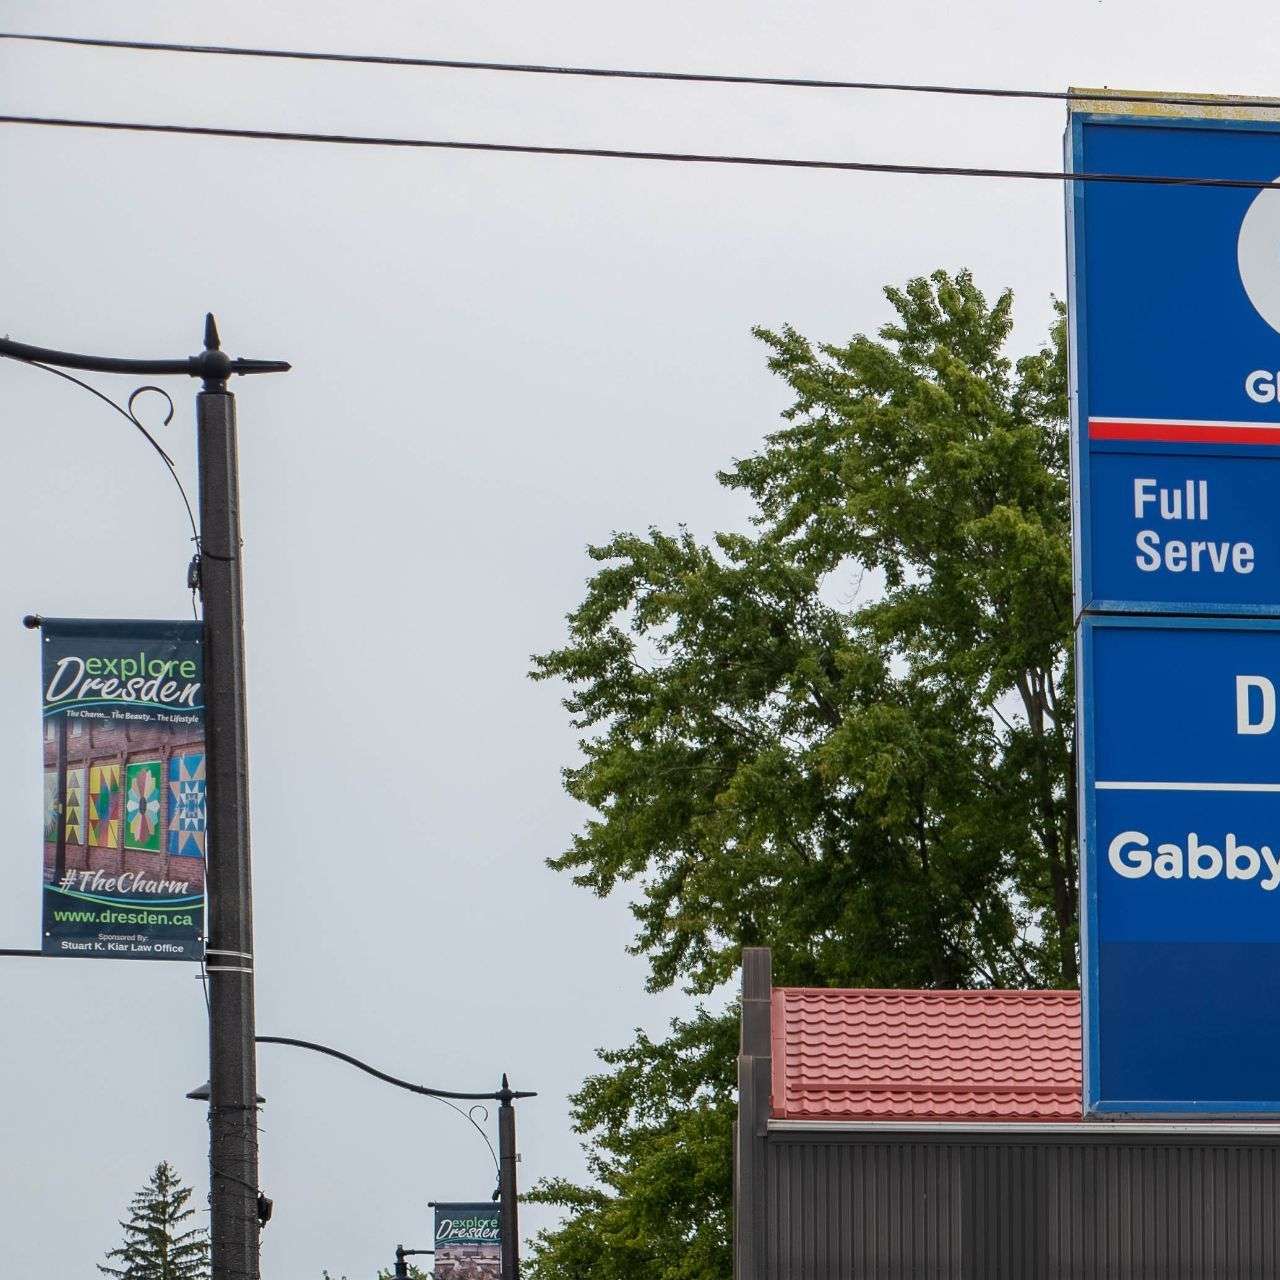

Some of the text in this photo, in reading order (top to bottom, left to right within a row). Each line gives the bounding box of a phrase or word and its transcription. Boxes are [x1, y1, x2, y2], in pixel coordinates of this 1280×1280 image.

[1133, 478, 1208, 520] Full
[1135, 530, 1255, 574] Serve
[85, 652, 196, 681] explore
[46, 656, 201, 706] Dresden
[111, 710, 125, 719] The
[157, 713, 169, 721] The
[169, 714, 199, 724] Lifestyle
[59, 869, 188, 894] #TheCharm
[54, 909, 193, 926] www.dresden.ca
[61, 941, 184, 953] Stuart K. Kiar Law Office
[98, 933, 136, 941] Sponsored
[436, 1219, 500, 1239] Dresden
[453, 1217, 498, 1231] explore
